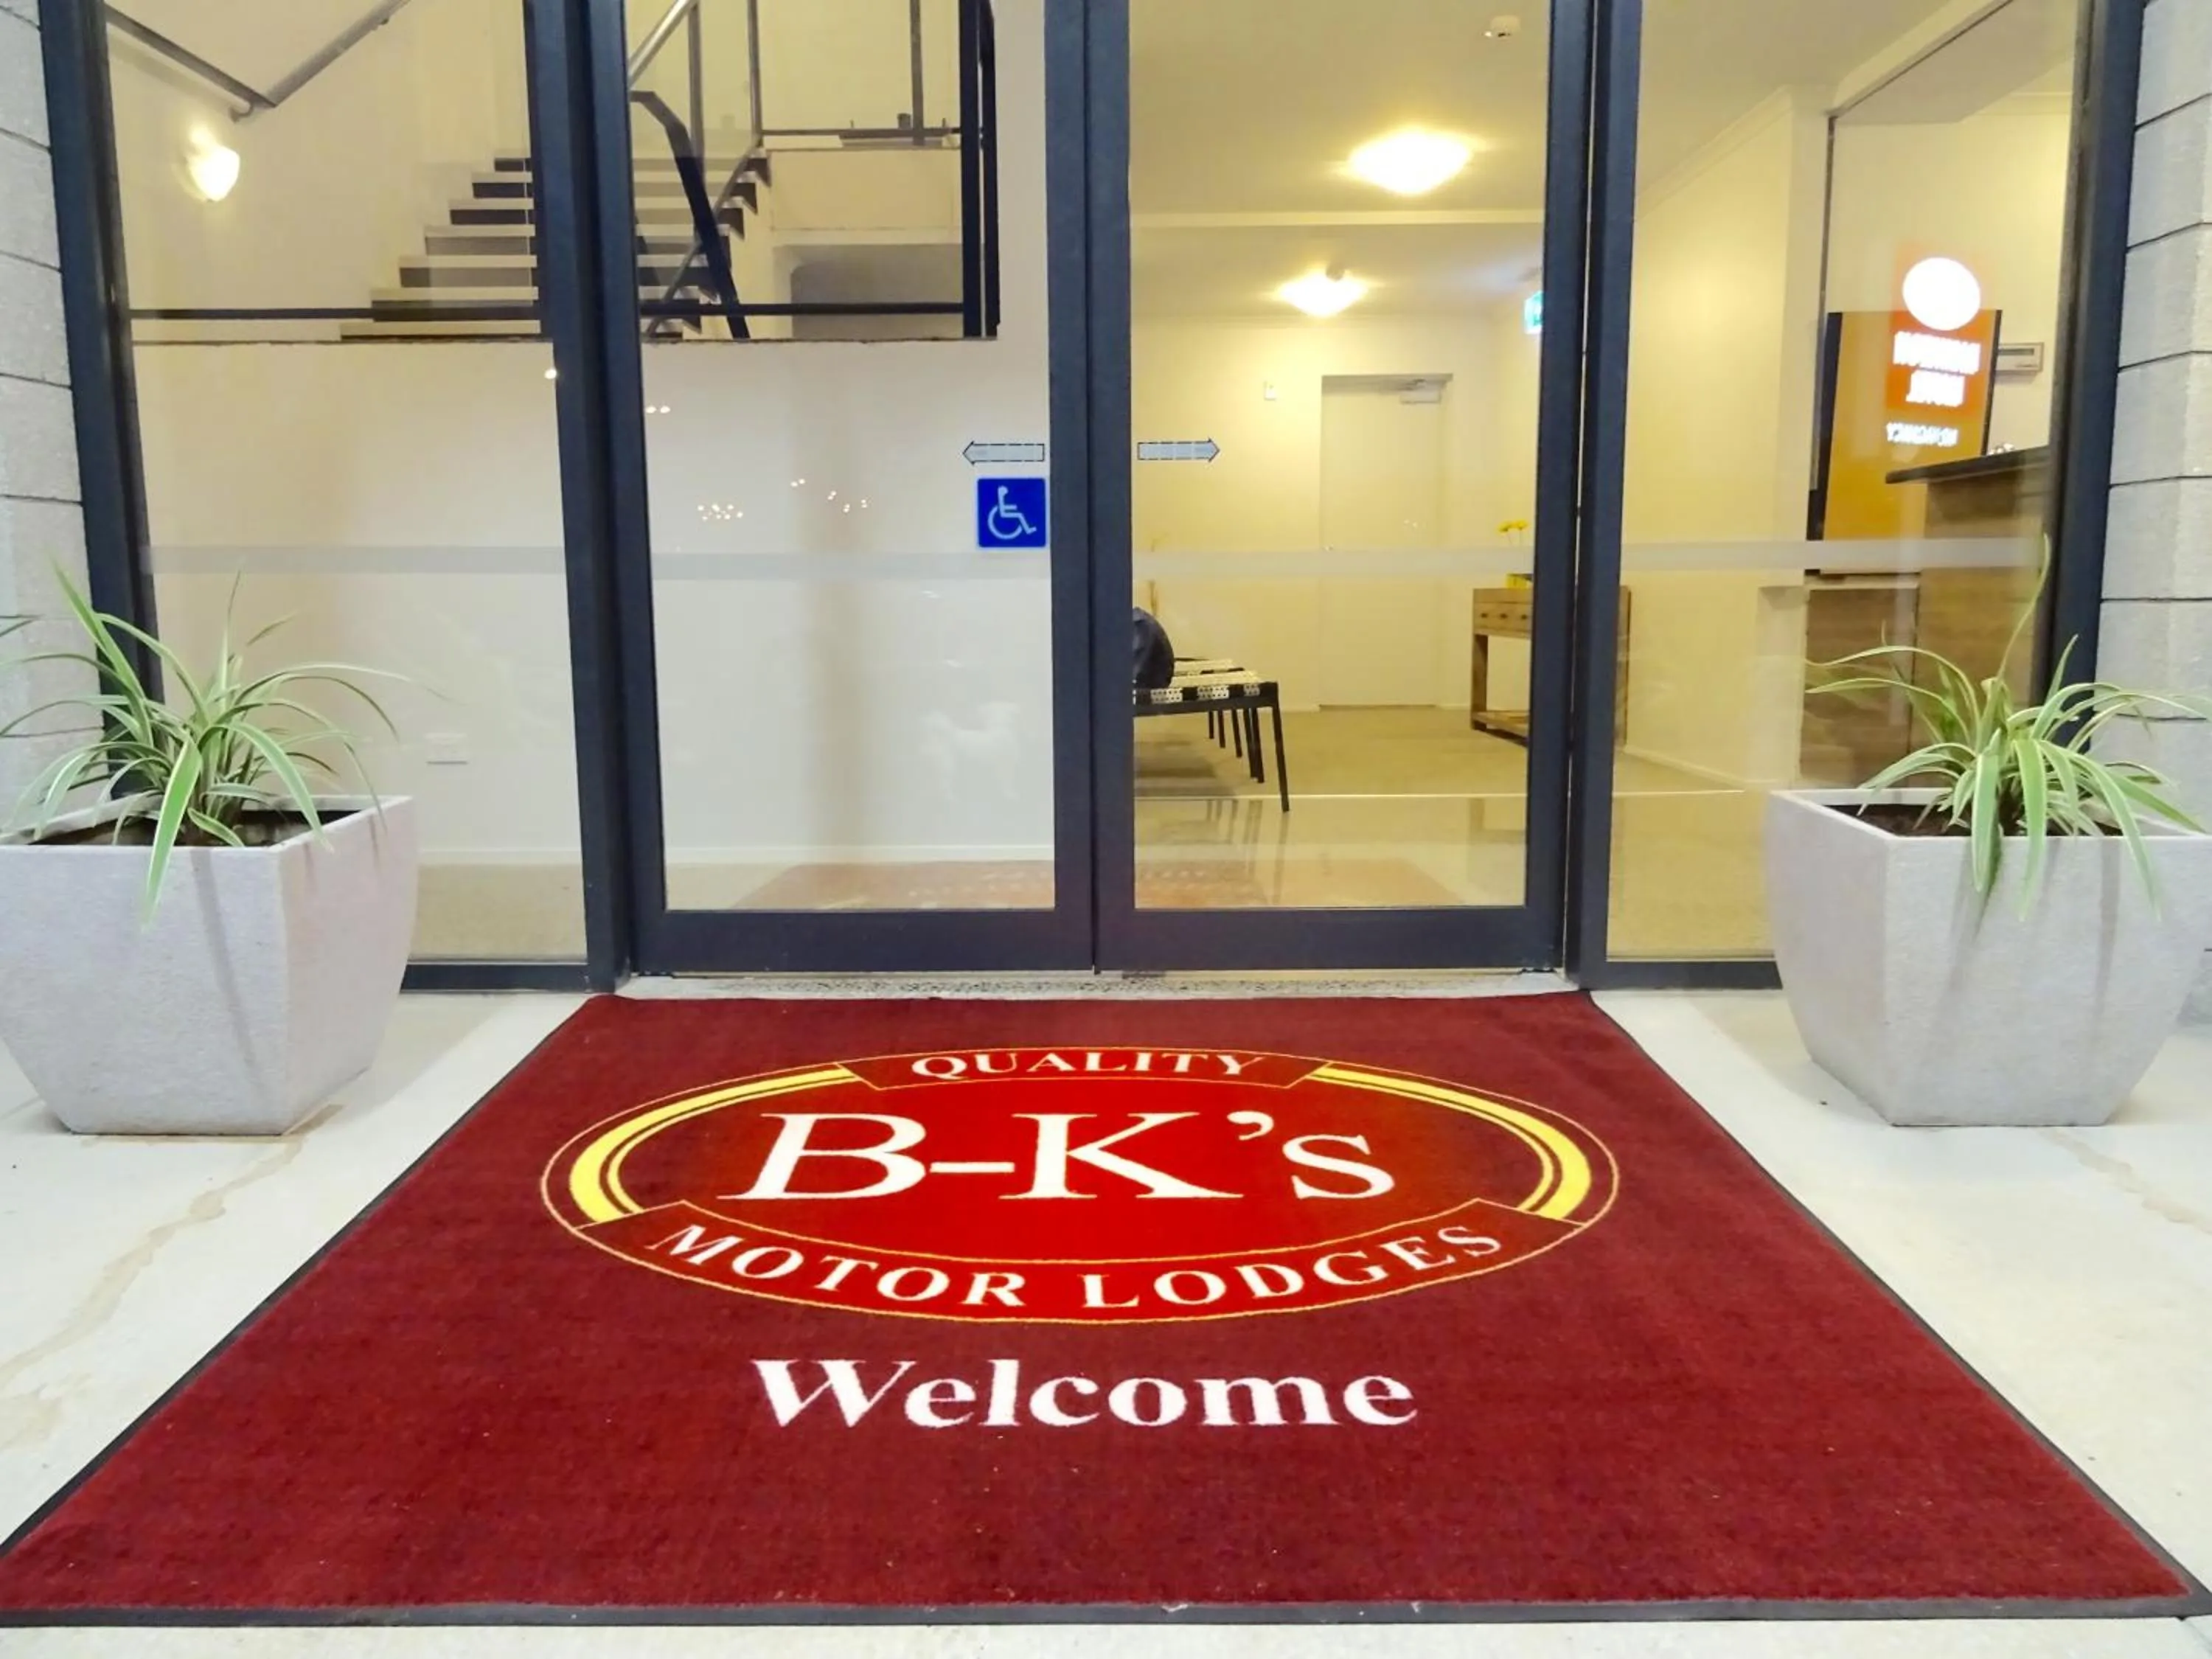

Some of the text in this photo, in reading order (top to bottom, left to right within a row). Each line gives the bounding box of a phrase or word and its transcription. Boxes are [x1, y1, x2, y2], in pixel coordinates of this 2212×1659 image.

[911, 1051, 1263, 1079] QUALITY
[644, 1225, 1502, 1308] MOTOR LODGES
[751, 1358, 1418, 1427] Welcome
